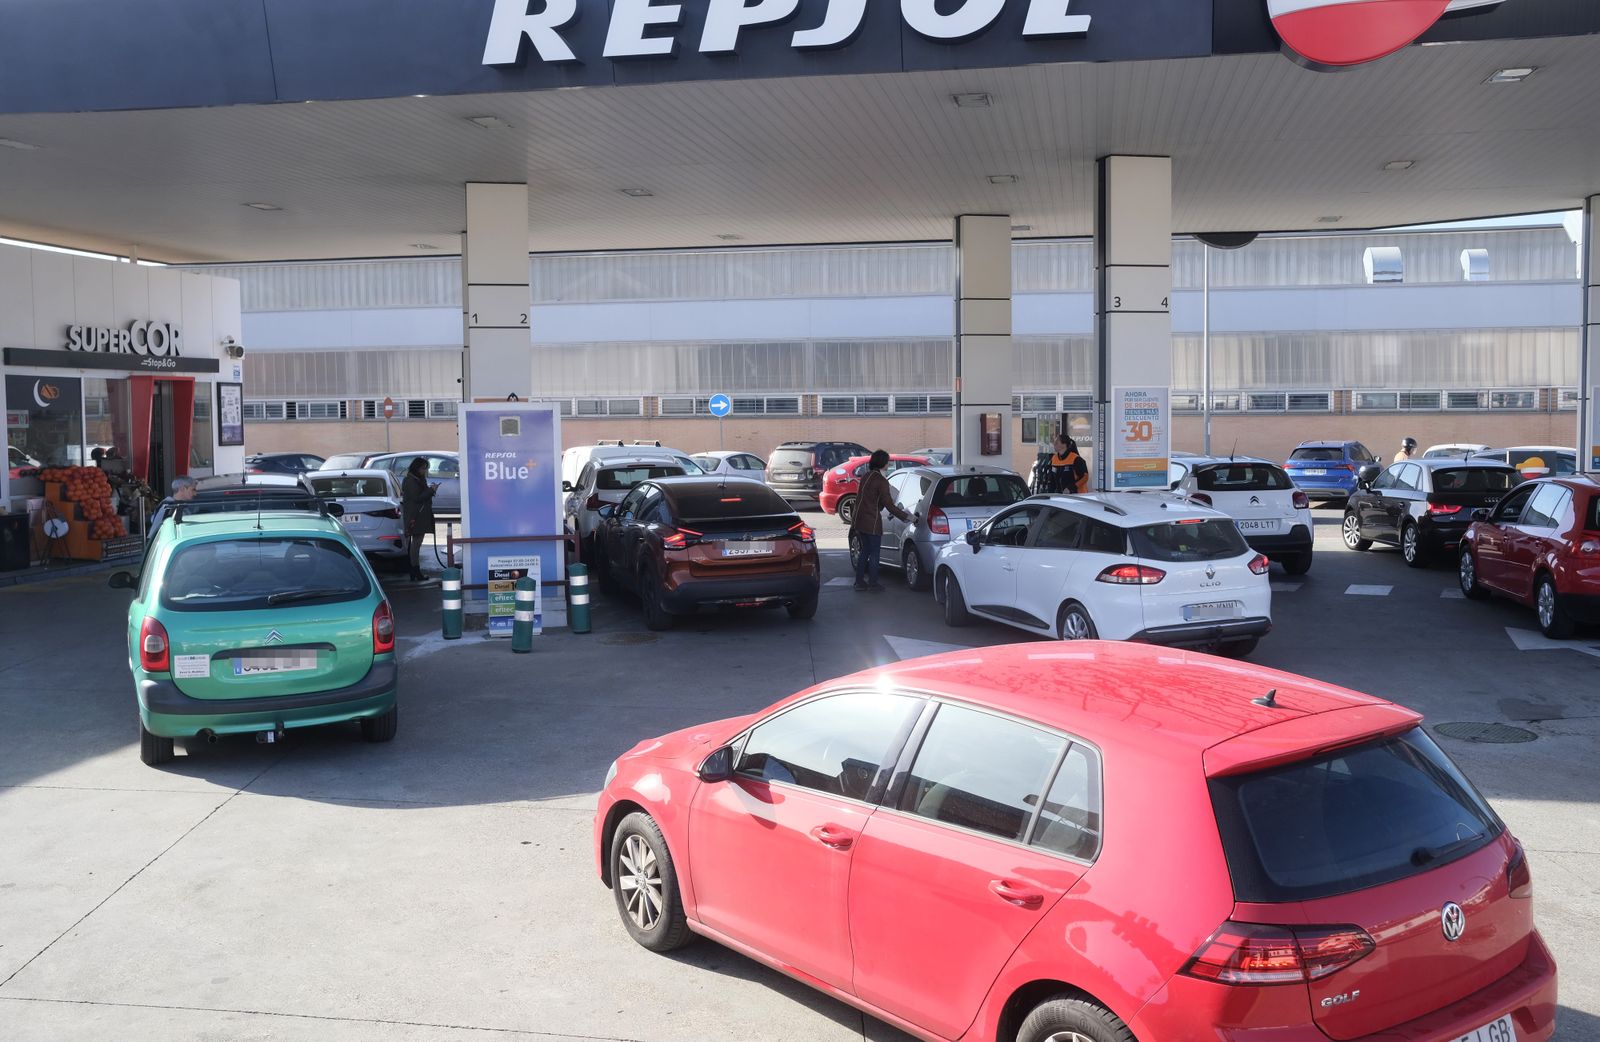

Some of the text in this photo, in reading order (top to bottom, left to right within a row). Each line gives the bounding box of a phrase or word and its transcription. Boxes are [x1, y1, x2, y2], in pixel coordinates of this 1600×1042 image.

[1113, 296, 1121, 308] 3
[1161, 296, 1168, 308] 4
[472, 313, 478, 324] 1
[520, 313, 528, 324] 2
[67, 319, 182, 357] SUPERCOR
[147, 357, 176, 369] Stop&Go
[1240, 520, 1275, 529] 2048 LTT
[1320, 989, 1360, 1008] GOLF
